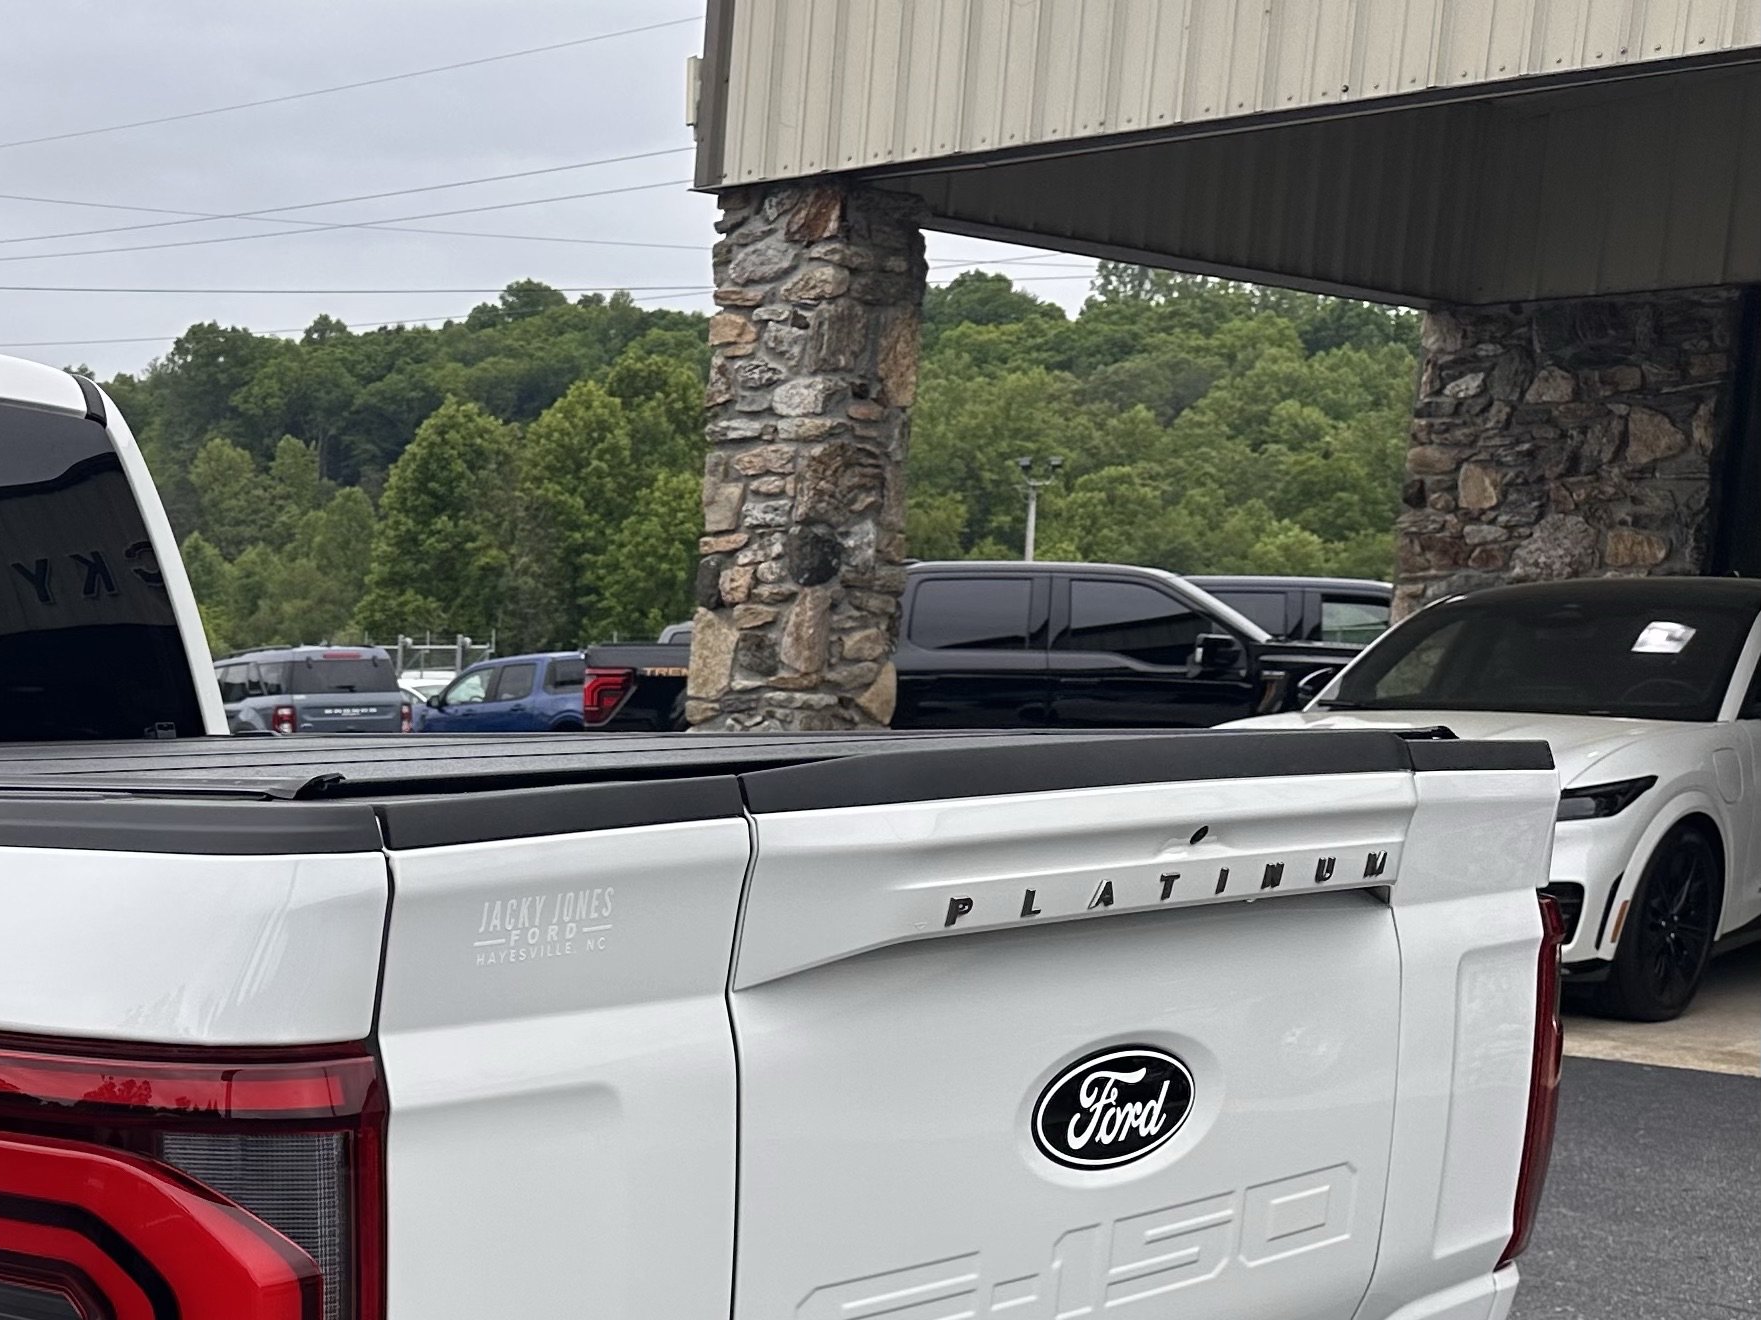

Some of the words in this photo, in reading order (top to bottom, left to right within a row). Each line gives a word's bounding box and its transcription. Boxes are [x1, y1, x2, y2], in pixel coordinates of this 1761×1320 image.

[478, 895, 547, 934] JACKY
[552, 886, 615, 924] JONES
[944, 850, 1388, 927] PLATINUM
[509, 922, 577, 947] FORD
[586, 936, 607, 951] NC
[1066, 1066, 1172, 1151] Ford
